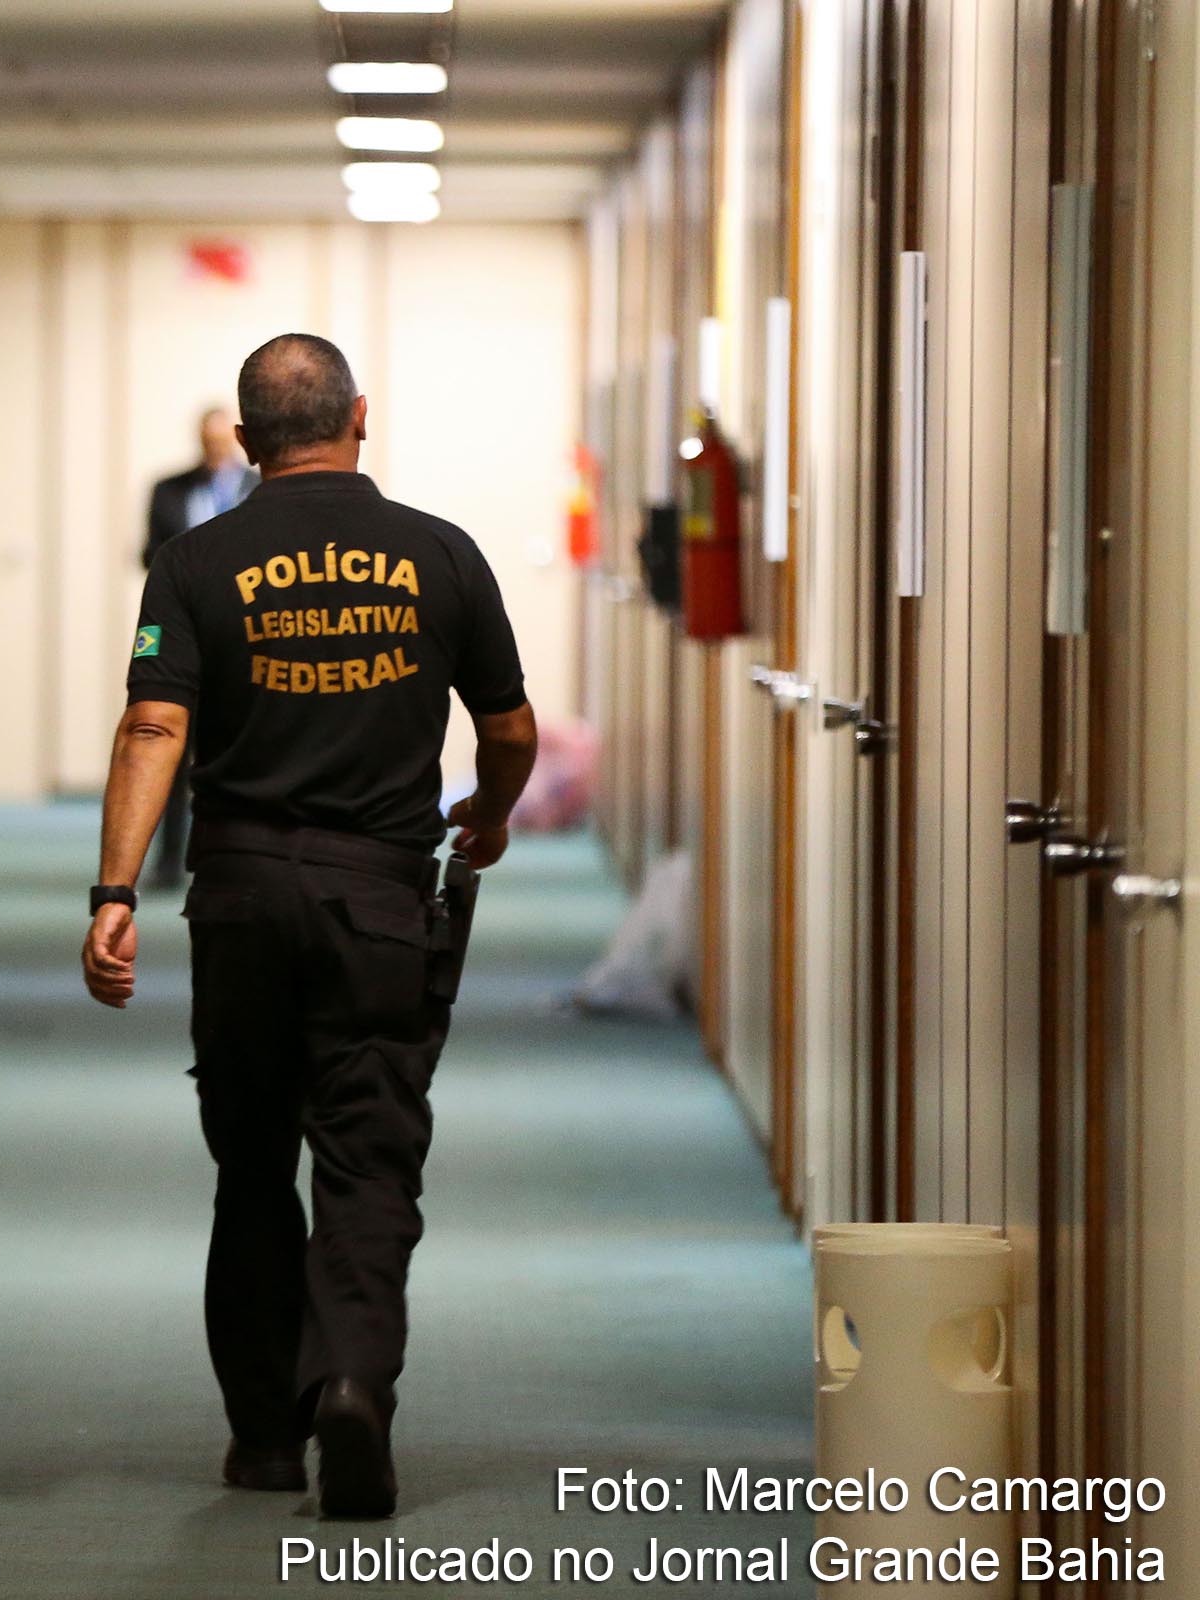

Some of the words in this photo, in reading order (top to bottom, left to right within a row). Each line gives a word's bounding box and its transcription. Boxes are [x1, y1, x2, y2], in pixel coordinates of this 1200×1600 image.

[234, 541, 420, 605] POLÍCIA
[243, 604, 420, 643] LEGISLATIVA
[250, 646, 420, 694] FEDERAL
